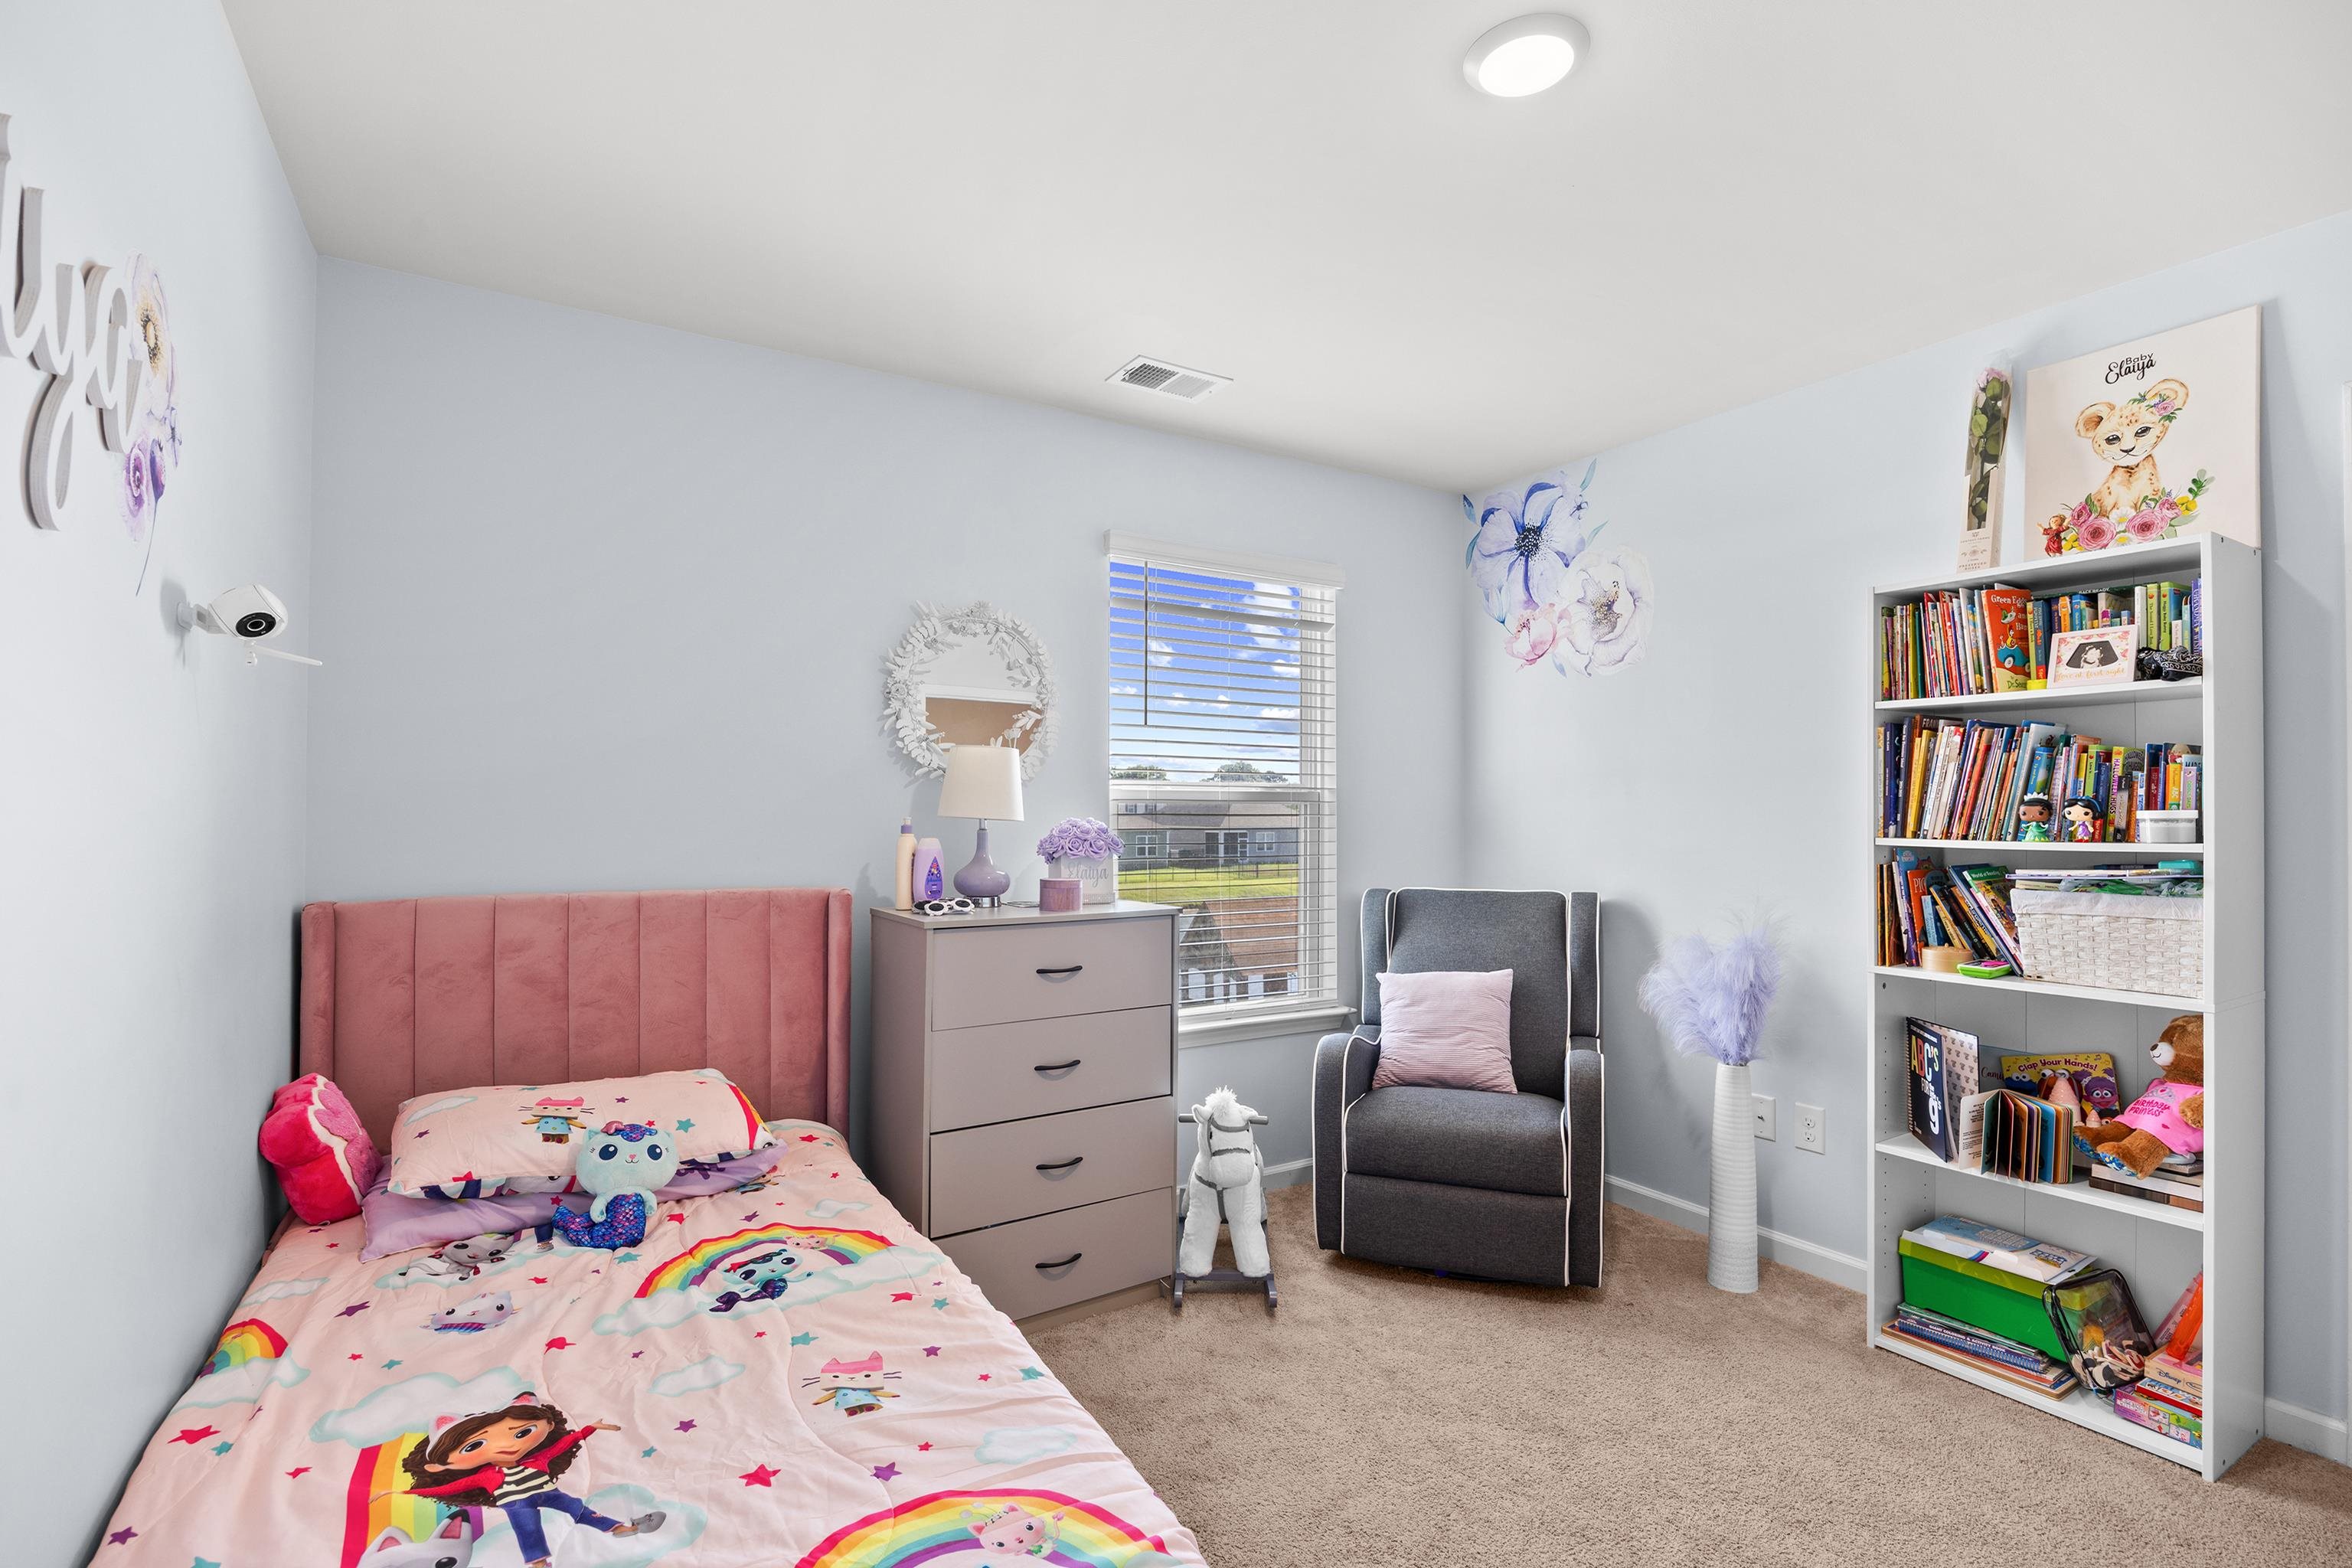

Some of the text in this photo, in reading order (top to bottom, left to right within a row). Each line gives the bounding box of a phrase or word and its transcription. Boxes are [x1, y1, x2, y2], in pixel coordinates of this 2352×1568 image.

[2125, 353, 2153, 364] Baby
[2105, 359, 2156, 384] Elaiya
[1991, 594, 2011, 604] Green
[2111, 758, 2120, 796] HALLOWEEN
[1067, 861, 1109, 888] Elaiya
[1911, 1035, 1939, 1081] ABC'S
[2018, 1058, 2098, 1072] Clap Your Hands!
[1921, 1077, 1929, 1096] FOR
[1943, 1329, 1965, 1340] COLORING
[1971, 1338, 1991, 1348] ACTIVITY
[1992, 1344, 2006, 1353] BOOK
[2156, 1367, 2181, 1384] Disney
